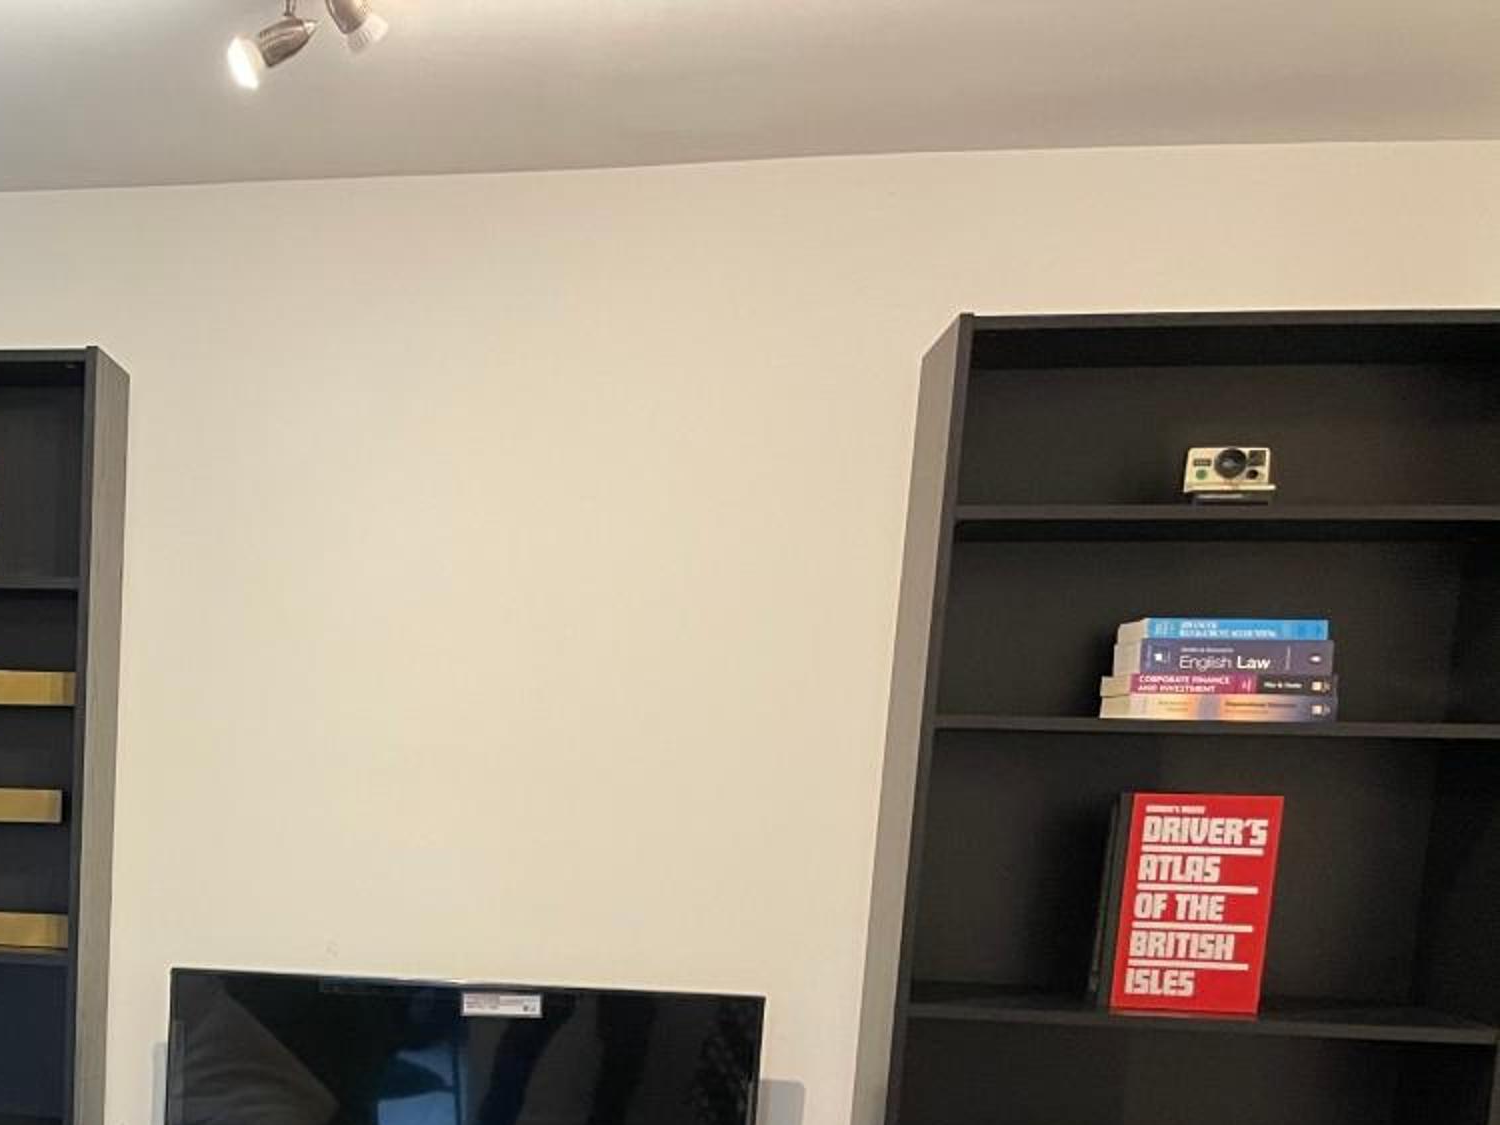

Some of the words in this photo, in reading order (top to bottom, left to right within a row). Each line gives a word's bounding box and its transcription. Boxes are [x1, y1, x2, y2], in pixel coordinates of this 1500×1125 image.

[1179, 655, 1232, 672] English
[1236, 655, 1271, 669] Law
[1139, 675, 1190, 684] CORPORATE
[1191, 676, 1230, 685] FINANCE
[1160, 684, 1217, 693] INVESTMENT
[1142, 815, 1269, 846] DRIVER'S
[1137, 854, 1221, 883] ATLAS
[1133, 892, 1167, 919] OF
[1175, 893, 1226, 922] THE
[1128, 930, 1235, 961] BRITISH
[1124, 967, 1196, 997] ISLES
